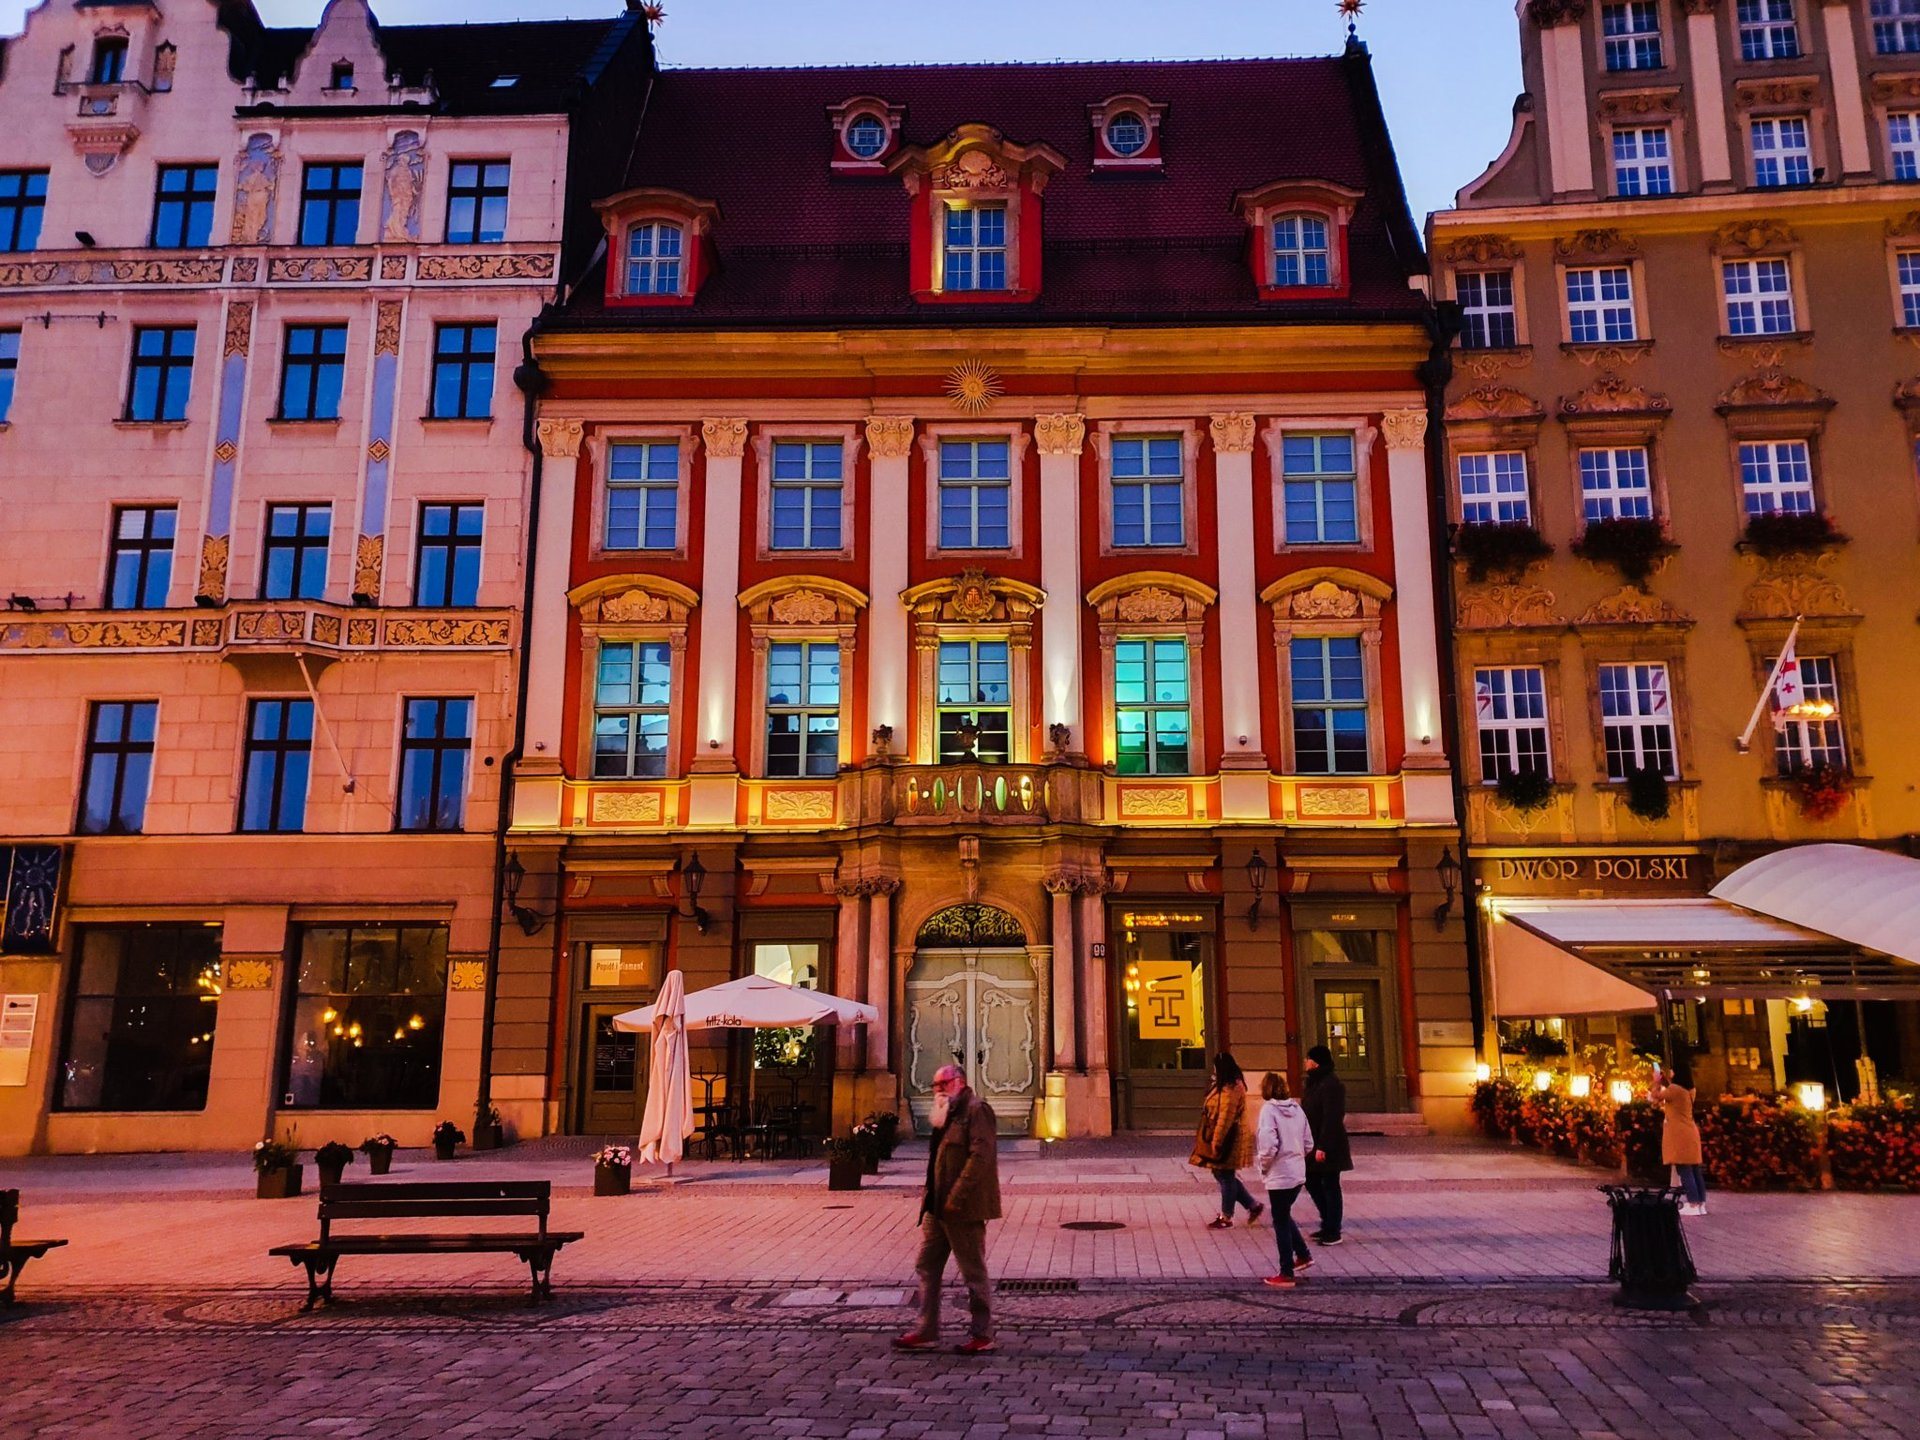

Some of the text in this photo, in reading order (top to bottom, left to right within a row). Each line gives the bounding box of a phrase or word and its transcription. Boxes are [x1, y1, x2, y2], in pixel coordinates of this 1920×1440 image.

[1498, 858, 1688, 880] DWÓR POLSKI
[706, 1014, 742, 1026] fritz-kola
